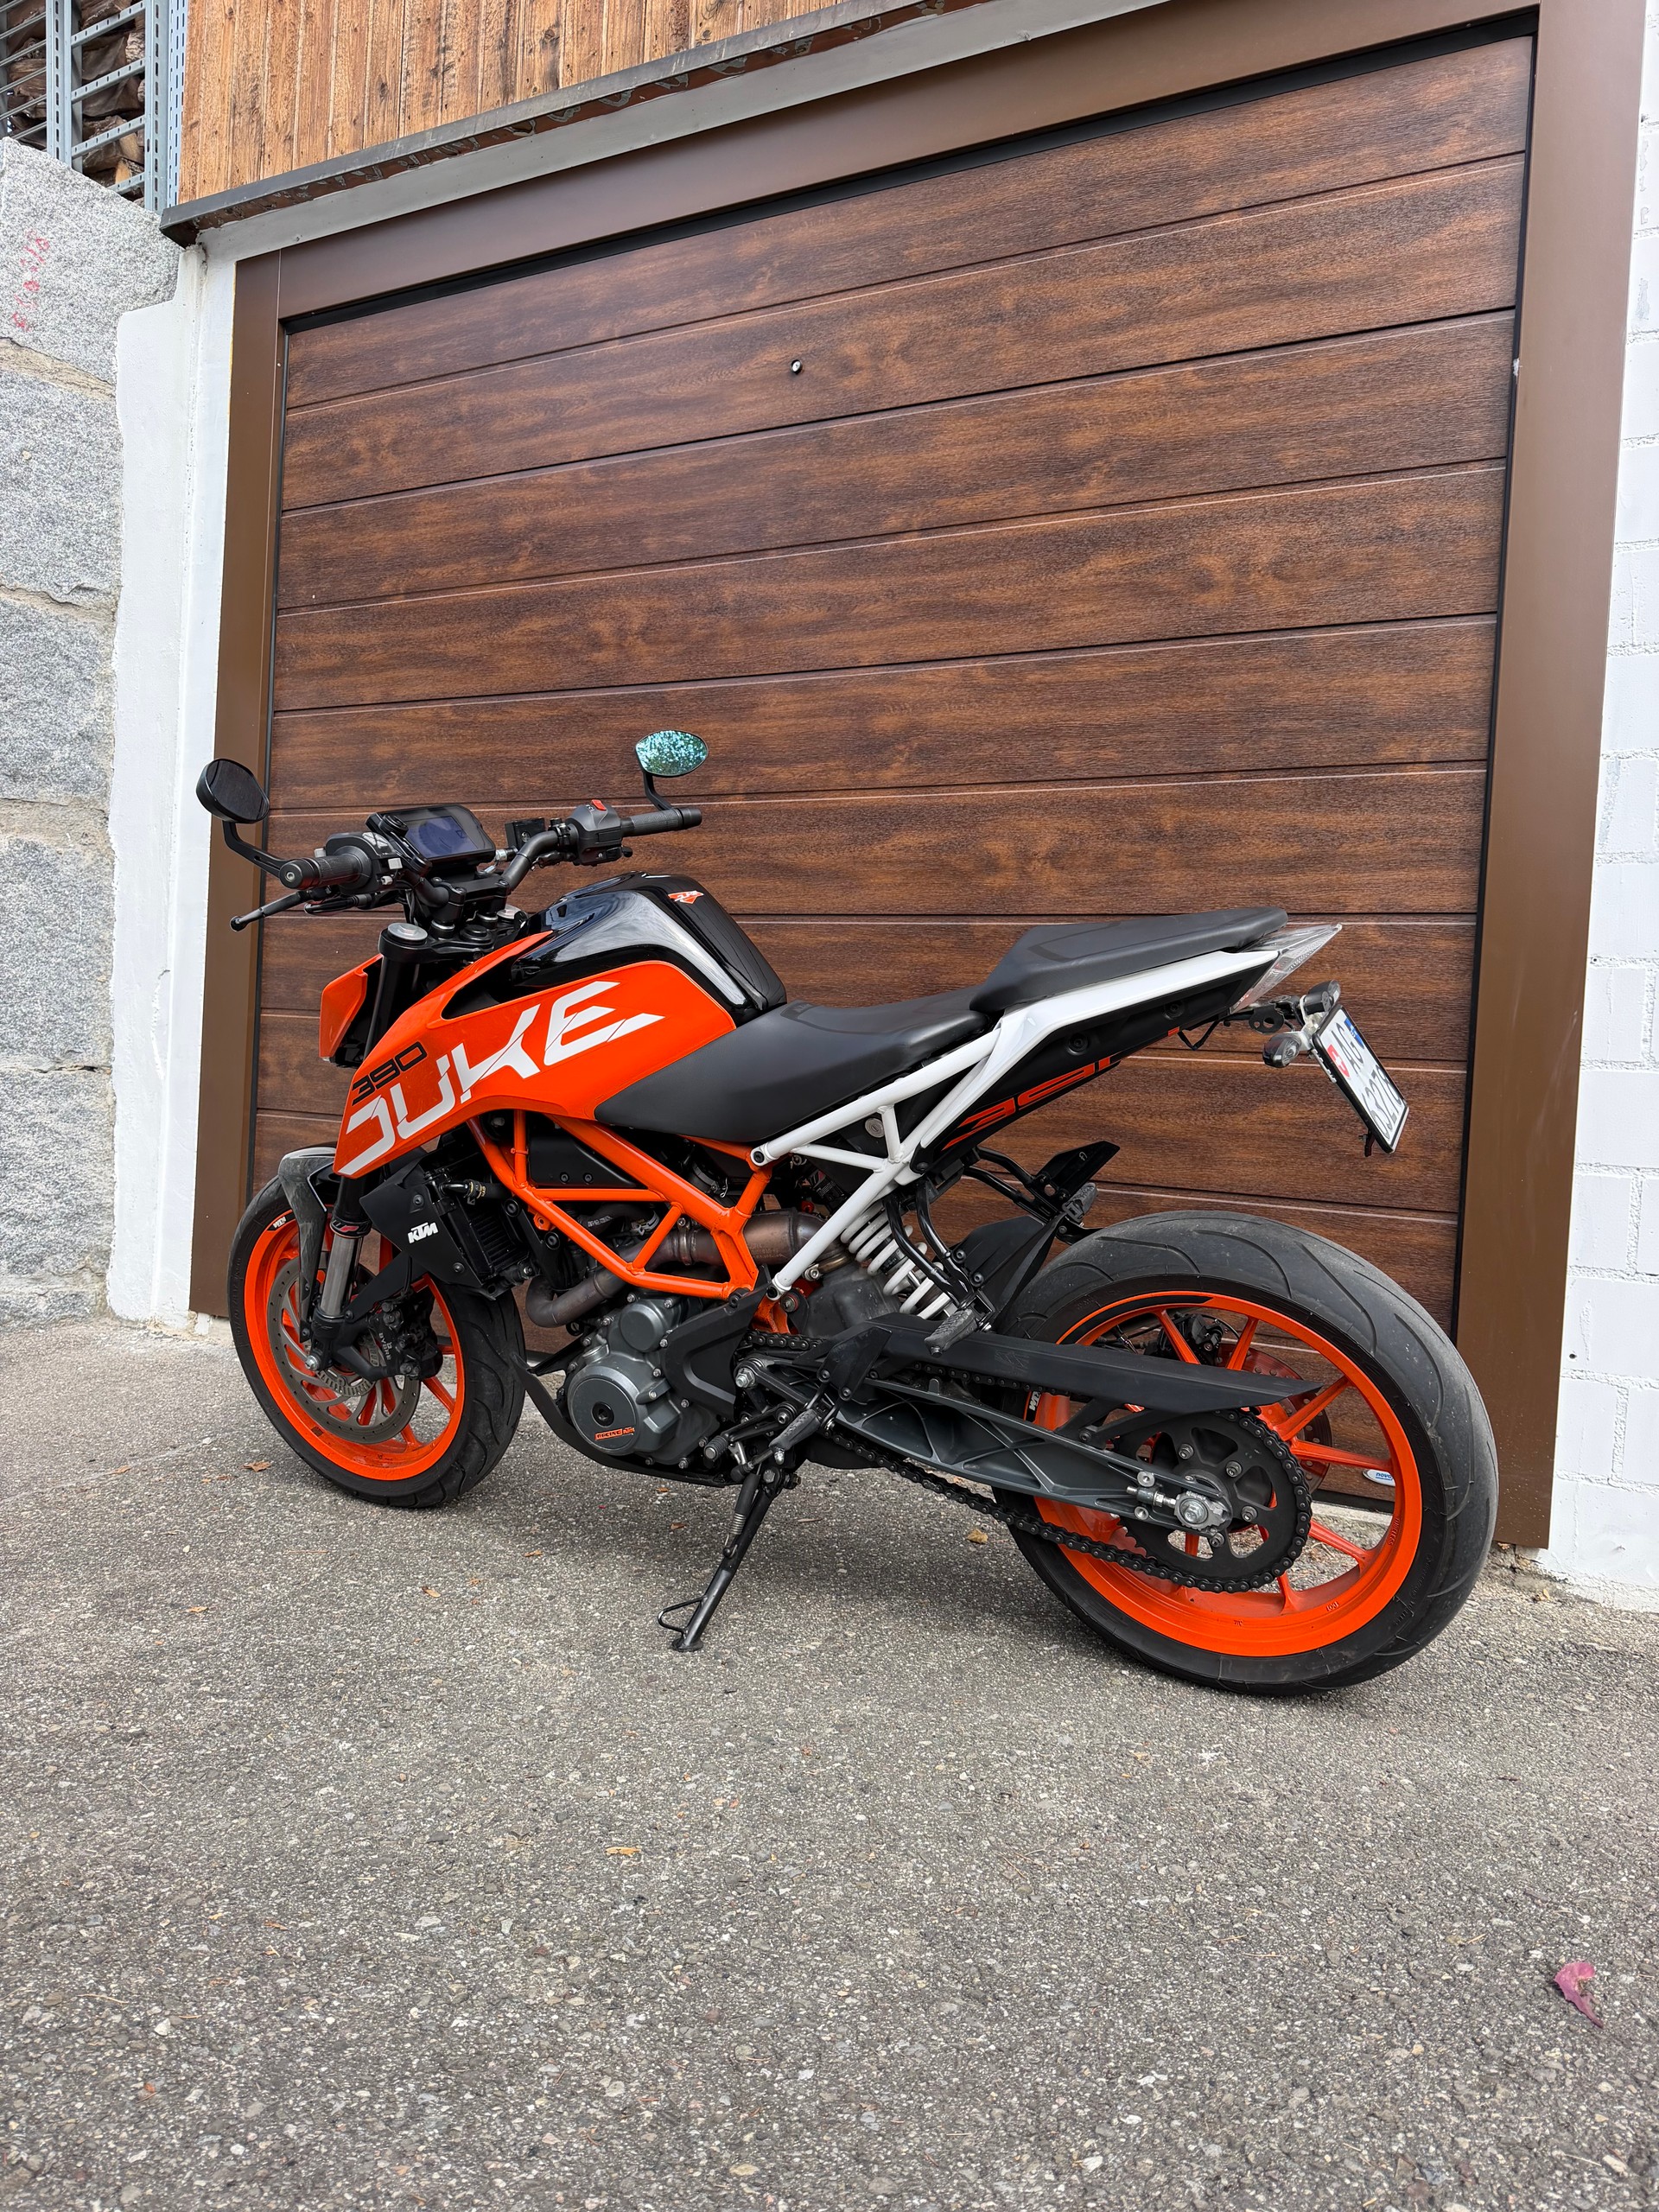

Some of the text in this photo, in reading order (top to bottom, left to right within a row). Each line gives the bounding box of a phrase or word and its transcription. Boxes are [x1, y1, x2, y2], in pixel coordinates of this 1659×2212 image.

[339, 981, 665, 1175] DUKE
[351, 1041, 428, 1106] 390
[1331, 1022, 1364, 1075] AG
[407, 1222, 439, 1244] KTM
